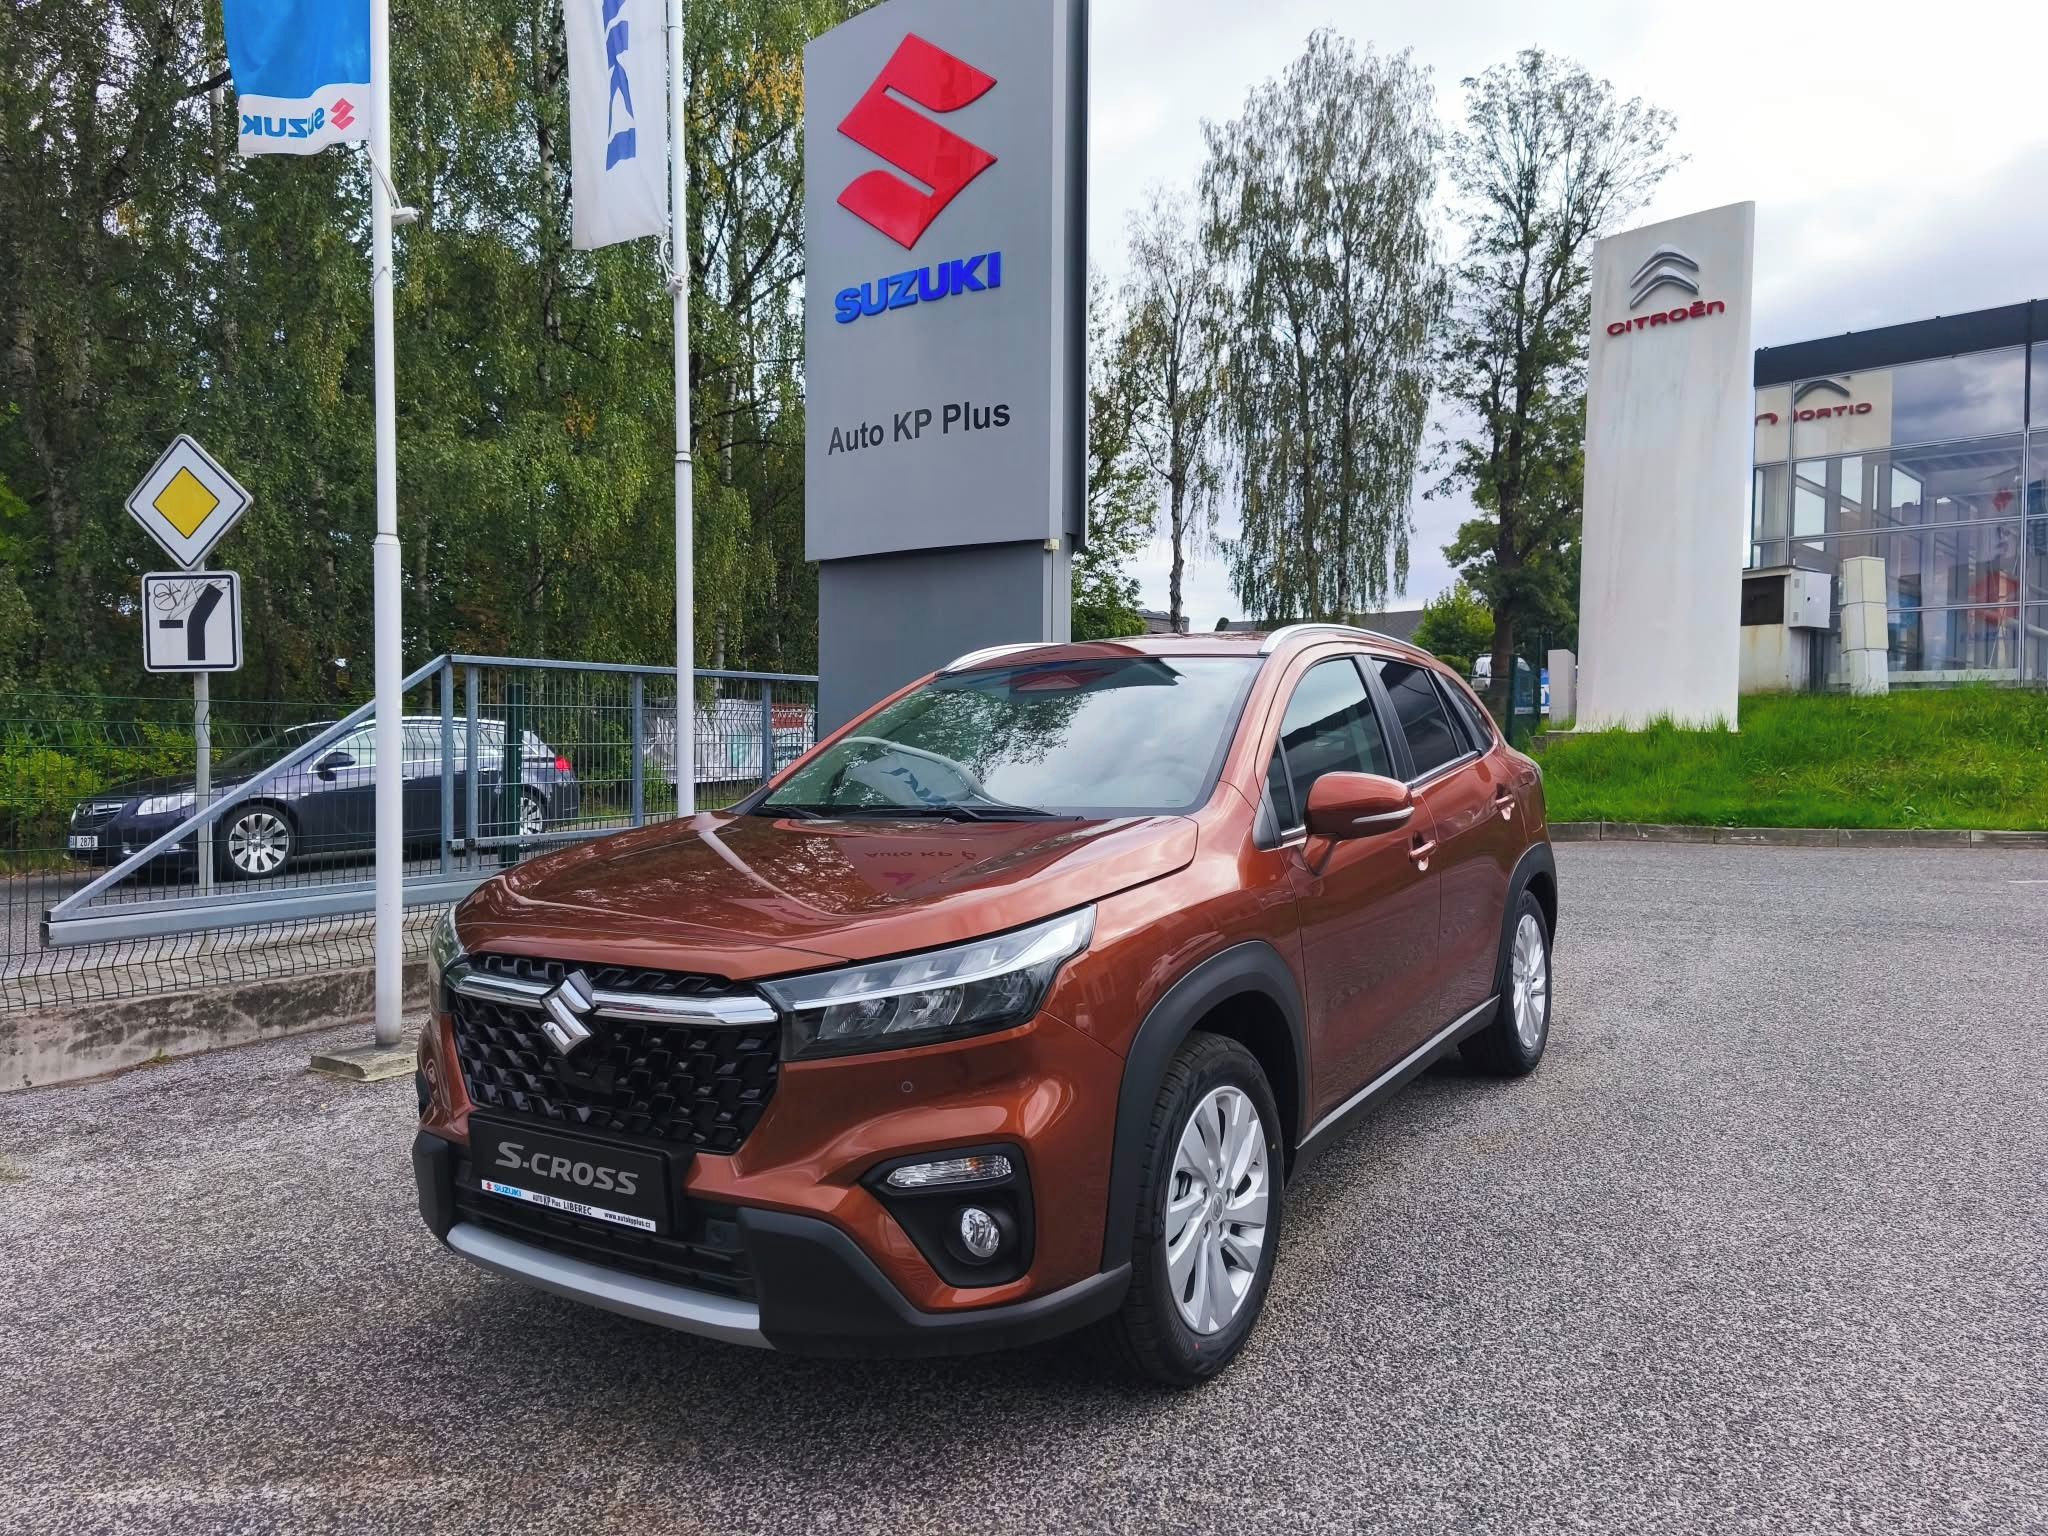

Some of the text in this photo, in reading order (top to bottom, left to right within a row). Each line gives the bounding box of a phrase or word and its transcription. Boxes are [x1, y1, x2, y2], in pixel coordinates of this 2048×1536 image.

[834, 251, 1002, 324] SUZUKI
[828, 401, 1011, 456] Auto KP Plus
[494, 1184, 522, 1197] SUZUKI
[563, 1201, 592, 1216] LIBEREC
